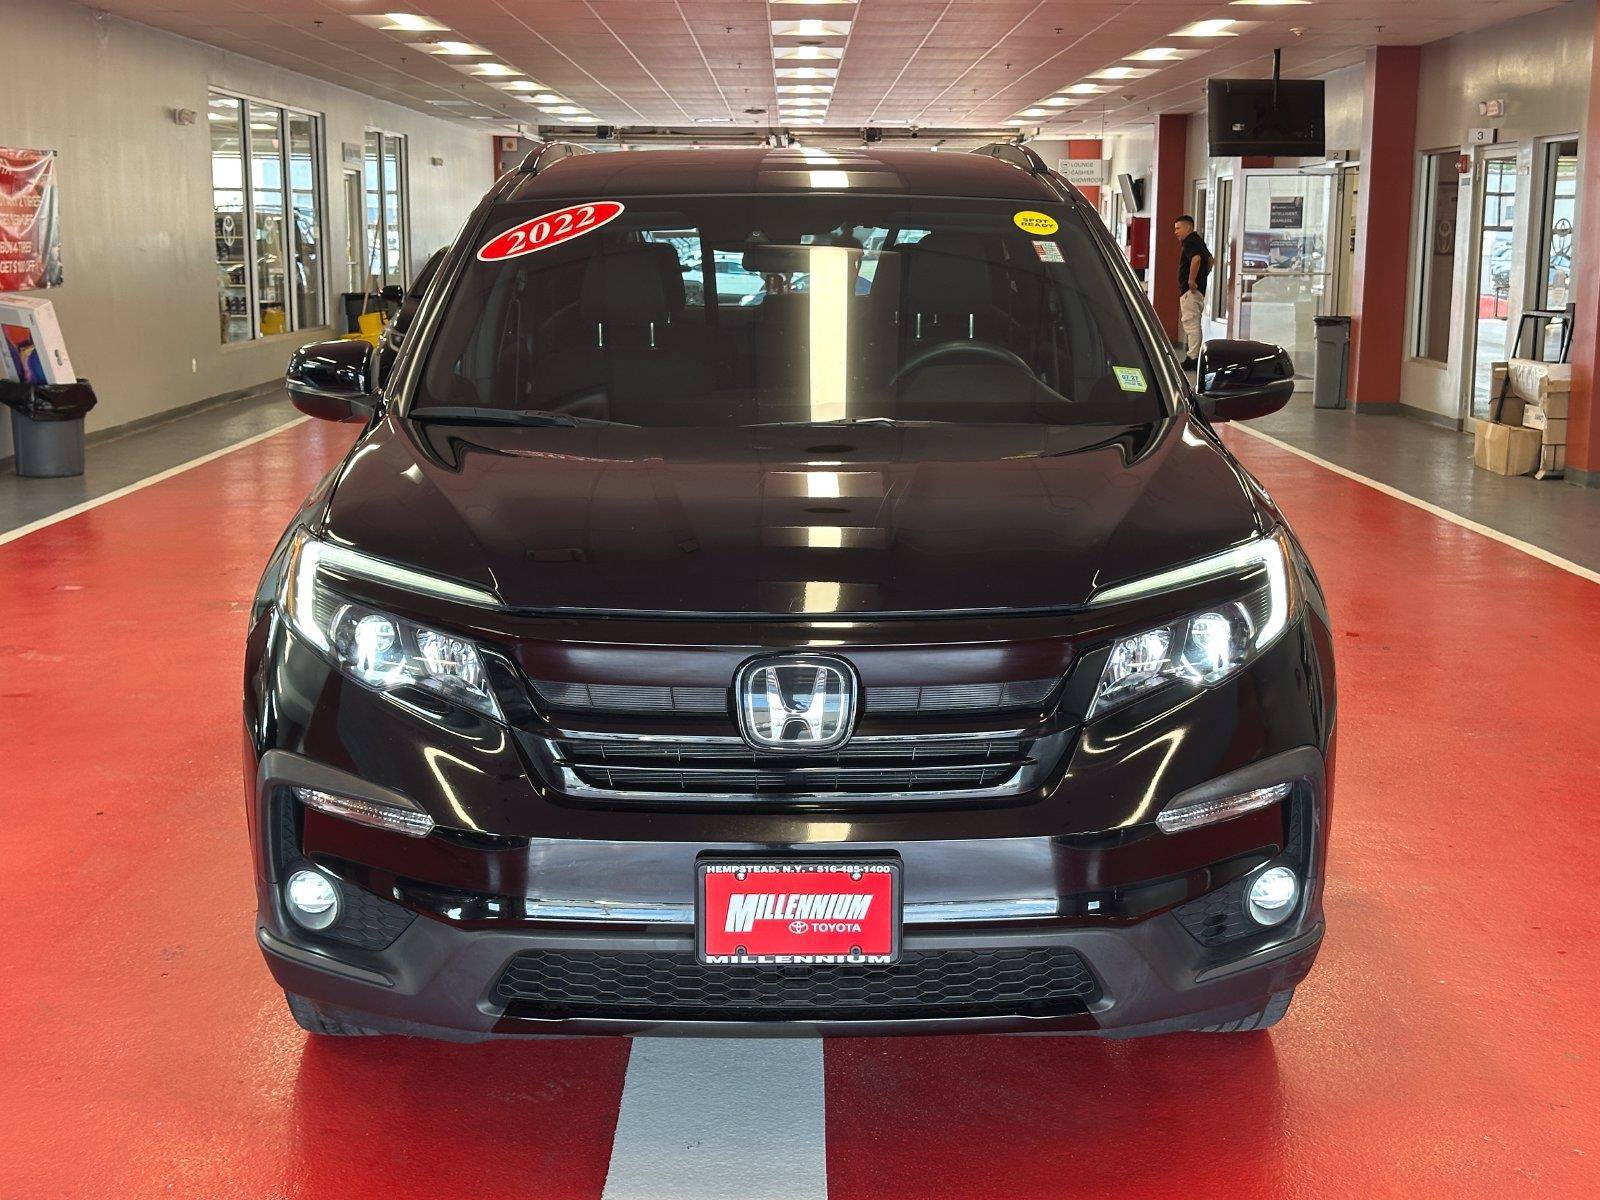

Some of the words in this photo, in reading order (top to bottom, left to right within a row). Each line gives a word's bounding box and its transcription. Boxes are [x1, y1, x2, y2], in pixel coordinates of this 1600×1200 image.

[1477, 131, 1484, 141] 3
[1333, 152, 1339, 160] 2
[505, 206, 597, 255] 2022
[0, 260, 12, 273] GET
[25, 259, 36, 273] OFF
[706, 865, 780, 874] HEMPSTEAD,
[782, 865, 805, 873] N.Y.
[816, 865, 891, 873] 516-485-1400
[724, 893, 874, 933] MILLENNIUM
[811, 923, 862, 932] TOYOTA
[705, 955, 891, 964] MILLENNIUM
